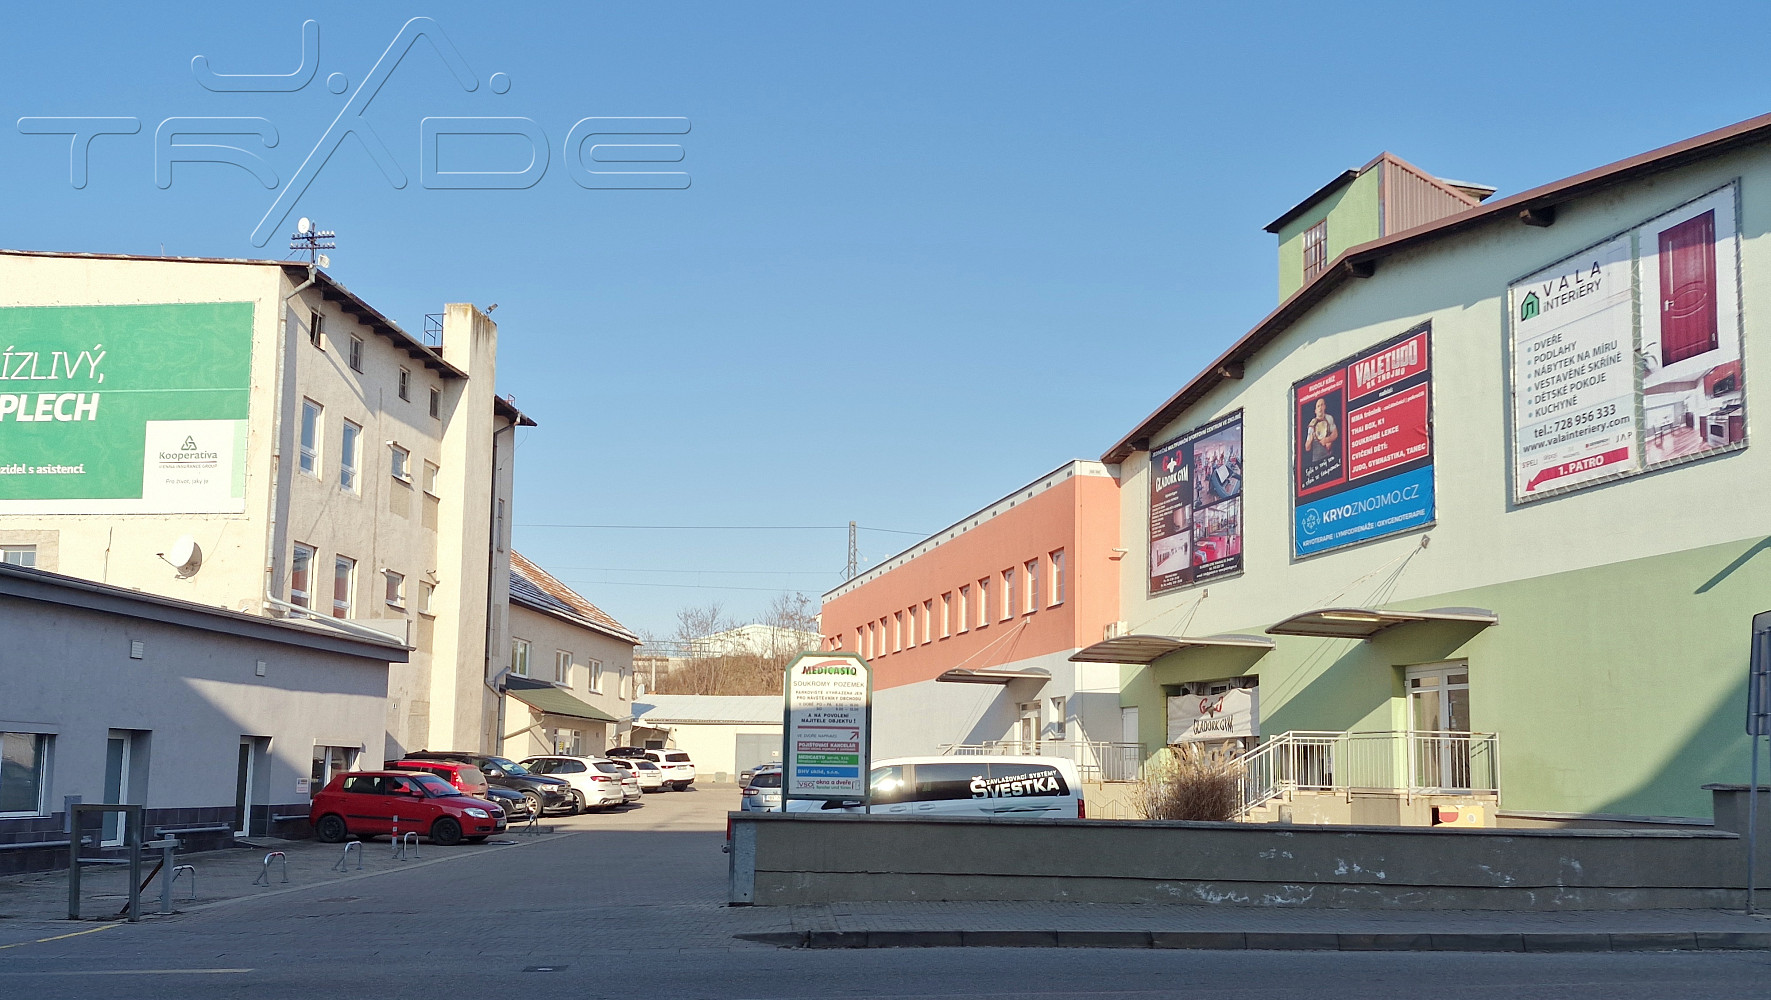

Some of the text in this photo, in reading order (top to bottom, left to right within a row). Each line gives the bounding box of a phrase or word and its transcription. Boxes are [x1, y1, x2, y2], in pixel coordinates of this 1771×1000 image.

[1543, 261, 1602, 297] VALA
[1534, 333, 1562, 351] DVEŘE
[1534, 341, 1577, 364] PODLAHY
[1355, 339, 1418, 388] VALETUDO
[1534, 340, 1618, 378] NÁBYTEK NA MÍRU
[1377, 367, 1406, 383] ZNOJMO
[1534, 352, 1622, 391] VESTAVĚNÉ SKŘÍNĚ
[1534, 372, 1606, 404] DĚTSKÉ POKOJE
[0, 393, 100, 422] PLECH
[1351, 413, 1364, 423] MMA
[1535, 395, 1578, 418] KUCHYNĚ
[1351, 418, 1385, 435] THAI BOX, K1
[1534, 404, 1616, 438] tel.: 728 956 333
[1351, 425, 1400, 448] SOUKROMÉ LEKCE
[1523, 415, 1630, 453] www.valainteriery.com
[159, 451, 218, 462] Kooperativa
[1351, 447, 1373, 460] CVIČENÍ
[1352, 443, 1426, 473] JUDO, GYMNASTIKA, TANEC
[1558, 466, 1568, 475] 1.
[1569, 455, 1604, 473] PATRO
[28, 466, 35, 475] s
[1156, 464, 1189, 492] GLADORK GYM
[1322, 484, 1420, 523] KRYOZNOJMO.CZ
[1302, 508, 1426, 547] KRYOTERAPIE LYMFODRENÁŽE OXYGENOTERAPIE
[801, 666, 857, 676] MEDICASTO
[1193, 714, 1234, 735] GLADORK GYM
[970, 775, 1060, 799] ŠVESTKA
[986, 770, 1057, 785] ZAVLAŽOVACÍ SYSTÉMY
